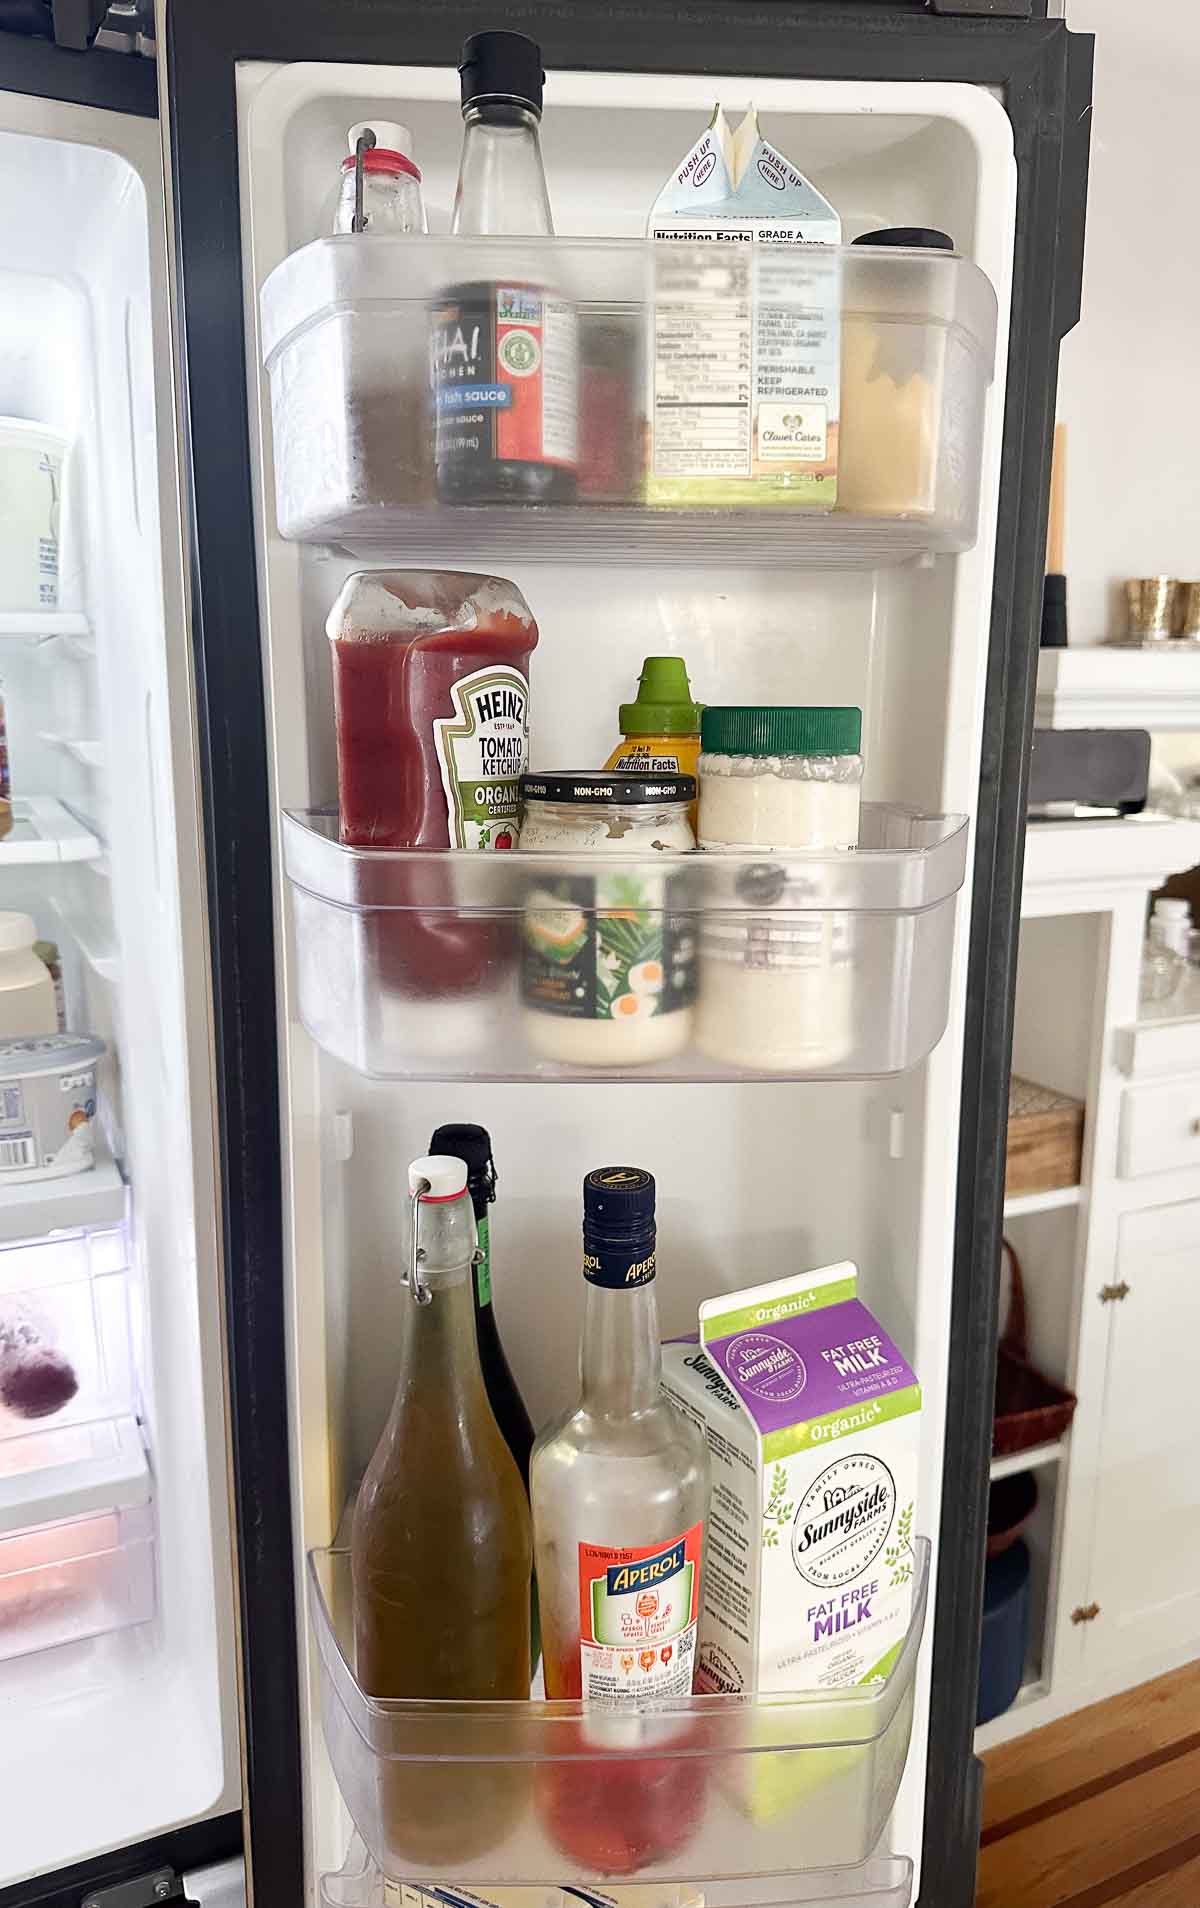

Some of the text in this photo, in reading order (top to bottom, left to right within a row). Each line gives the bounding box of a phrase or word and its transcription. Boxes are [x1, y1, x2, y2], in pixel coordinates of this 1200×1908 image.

[678, 139, 711, 184] PUSH UP
[696, 159, 712, 181] HERE
[762, 148, 802, 187] PUSH UP
[762, 164, 780, 184] HERE
[758, 230, 804, 239] GRADE A
[758, 365, 815, 374] PERISHABLE
[758, 376, 782, 385] KEEP
[464, 390, 506, 401] sauce
[757, 386, 829, 397] REFRIGERATED
[455, 414, 484, 423] sauce
[476, 690, 525, 724] HEINZ
[479, 737, 523, 758] TOMATO
[482, 758, 521, 776] KETCHUP
[615, 757, 676, 771] Nutrition Facts
[475, 784, 521, 805] ORGANI
[574, 786, 613, 797] NON-GMO
[645, 786, 677, 795] NON-GMO
[756, 1296, 811, 1321] Organic
[821, 1335, 882, 1362] FAT FREE
[738, 1347, 791, 1382] Sunnyside
[833, 1347, 889, 1377] MILK
[711, 1389, 741, 1410] FARMS
[810, 1410, 876, 1441] Organic
[797, 1484, 887, 1552] Sunnyside
[853, 1501, 887, 1530] FARMS
[613, 1552, 680, 1591] APEROL
[807, 1579, 879, 1622] FAT FREE
[813, 1597, 873, 1642] MILK
